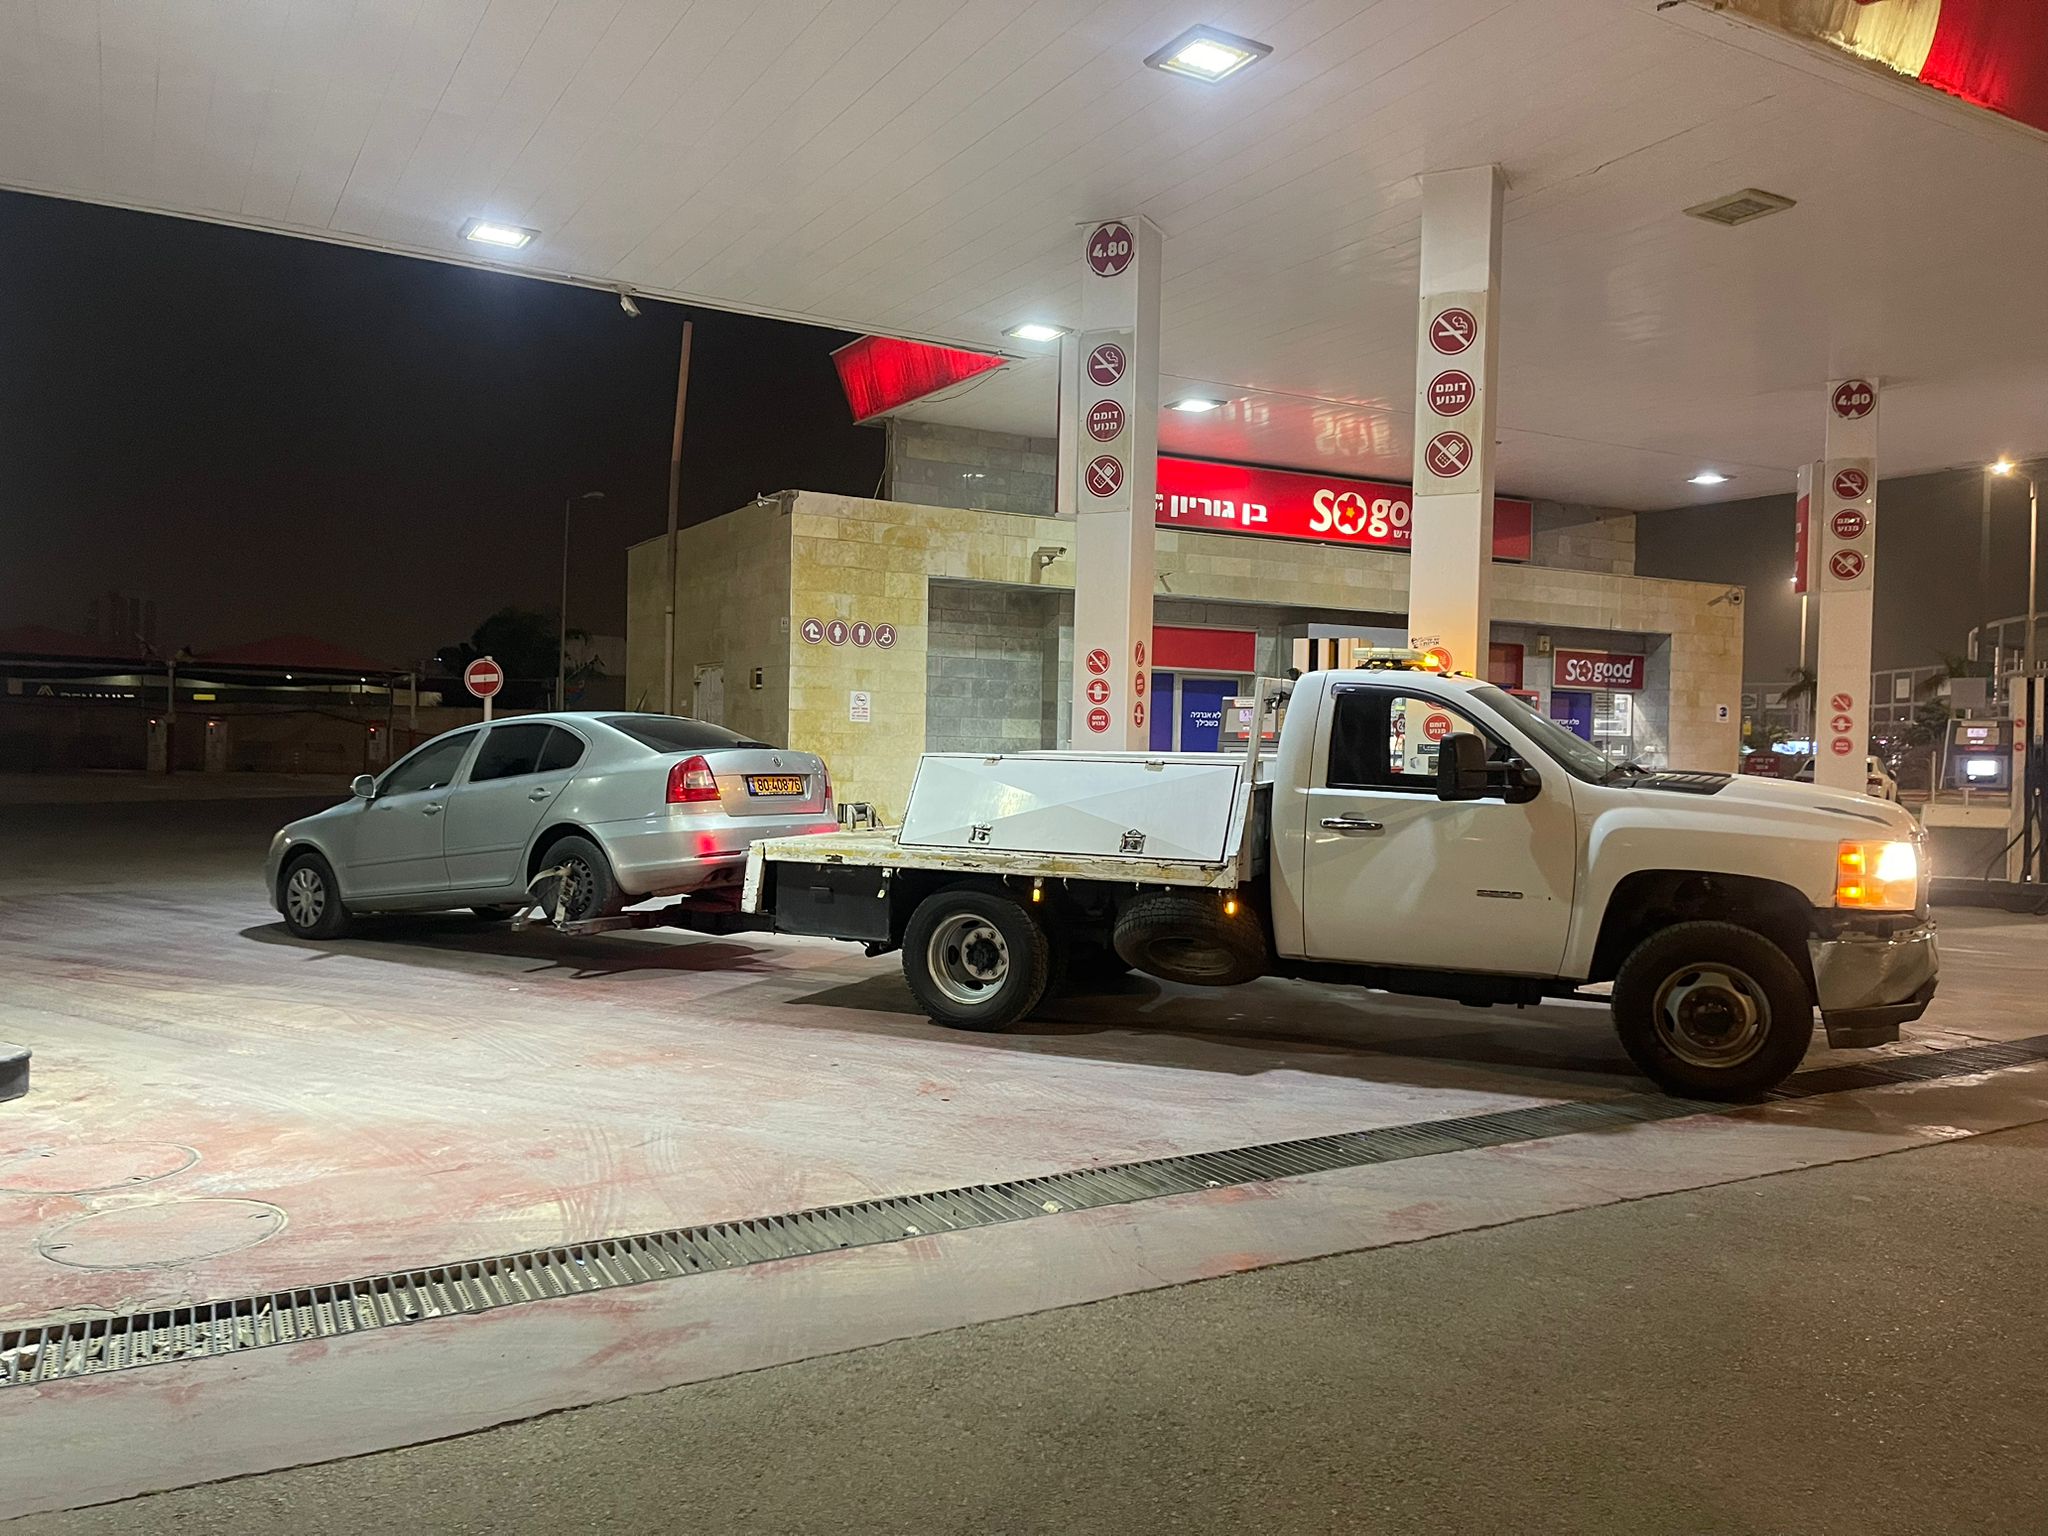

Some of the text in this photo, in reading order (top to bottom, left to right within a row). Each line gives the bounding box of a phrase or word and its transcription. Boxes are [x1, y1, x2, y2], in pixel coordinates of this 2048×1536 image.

[1092, 240, 1129, 258] 4.80
[1435, 382, 1467, 393] דומם
[1435, 394, 1466, 406] מנוע
[1093, 410, 1119, 421] דומם
[1093, 422, 1118, 432] מנוע
[1170, 495, 1235, 519] גוריון
[1242, 503, 1268, 525] בן
